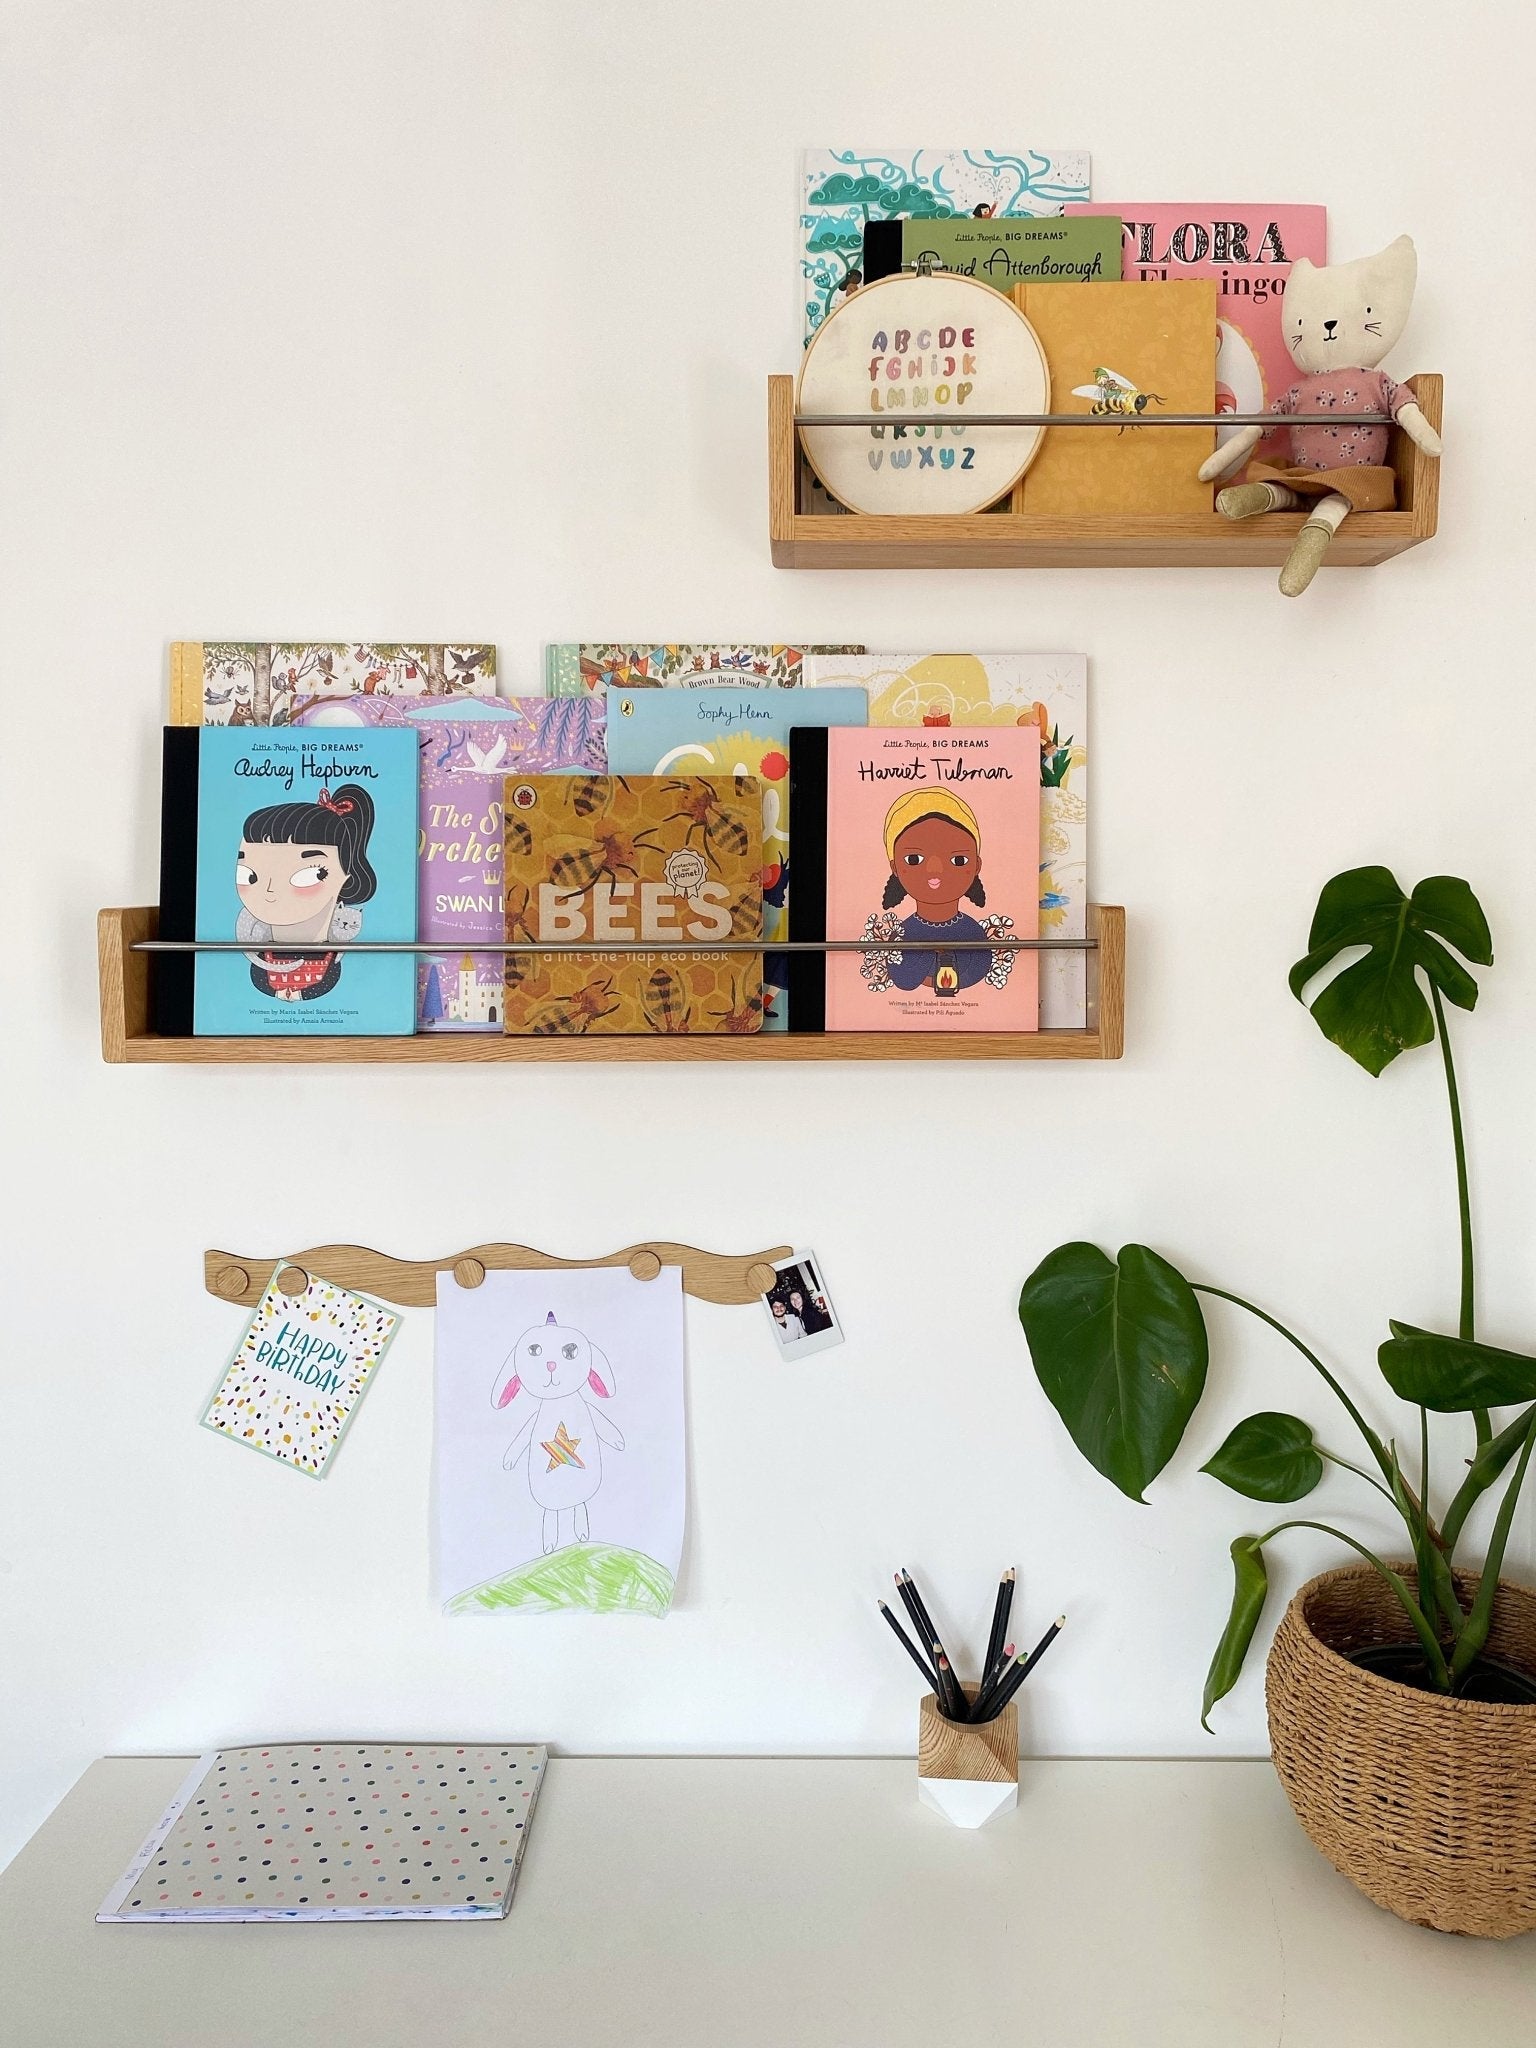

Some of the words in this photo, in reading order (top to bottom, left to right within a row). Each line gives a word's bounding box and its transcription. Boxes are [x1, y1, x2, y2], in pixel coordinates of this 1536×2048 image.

[955, 233, 976, 242] Little
[1005, 231, 1022, 241] BIG
[983, 248, 1102, 282] Attenborough
[688, 677, 715, 689] Brown
[717, 675, 736, 684] Bear
[738, 676, 761, 689] Wood
[697, 701, 738, 726] Sophy
[739, 703, 773, 719] Henn
[251, 743, 272, 751] Little
[301, 743, 318, 752] BIG
[883, 740, 903, 748] Little
[932, 740, 949, 748] BIG
[951, 740, 990, 748] DREAMS
[301, 753, 379, 788] Hepburn
[857, 756, 927, 782] Harriet
[930, 757, 1013, 782] Tubman
[428, 803, 473, 829] The
[435, 894, 493, 913] SWAN
[538, 881, 733, 942] BEES
[661, 952, 687, 962] eco
[692, 952, 729, 962] book
